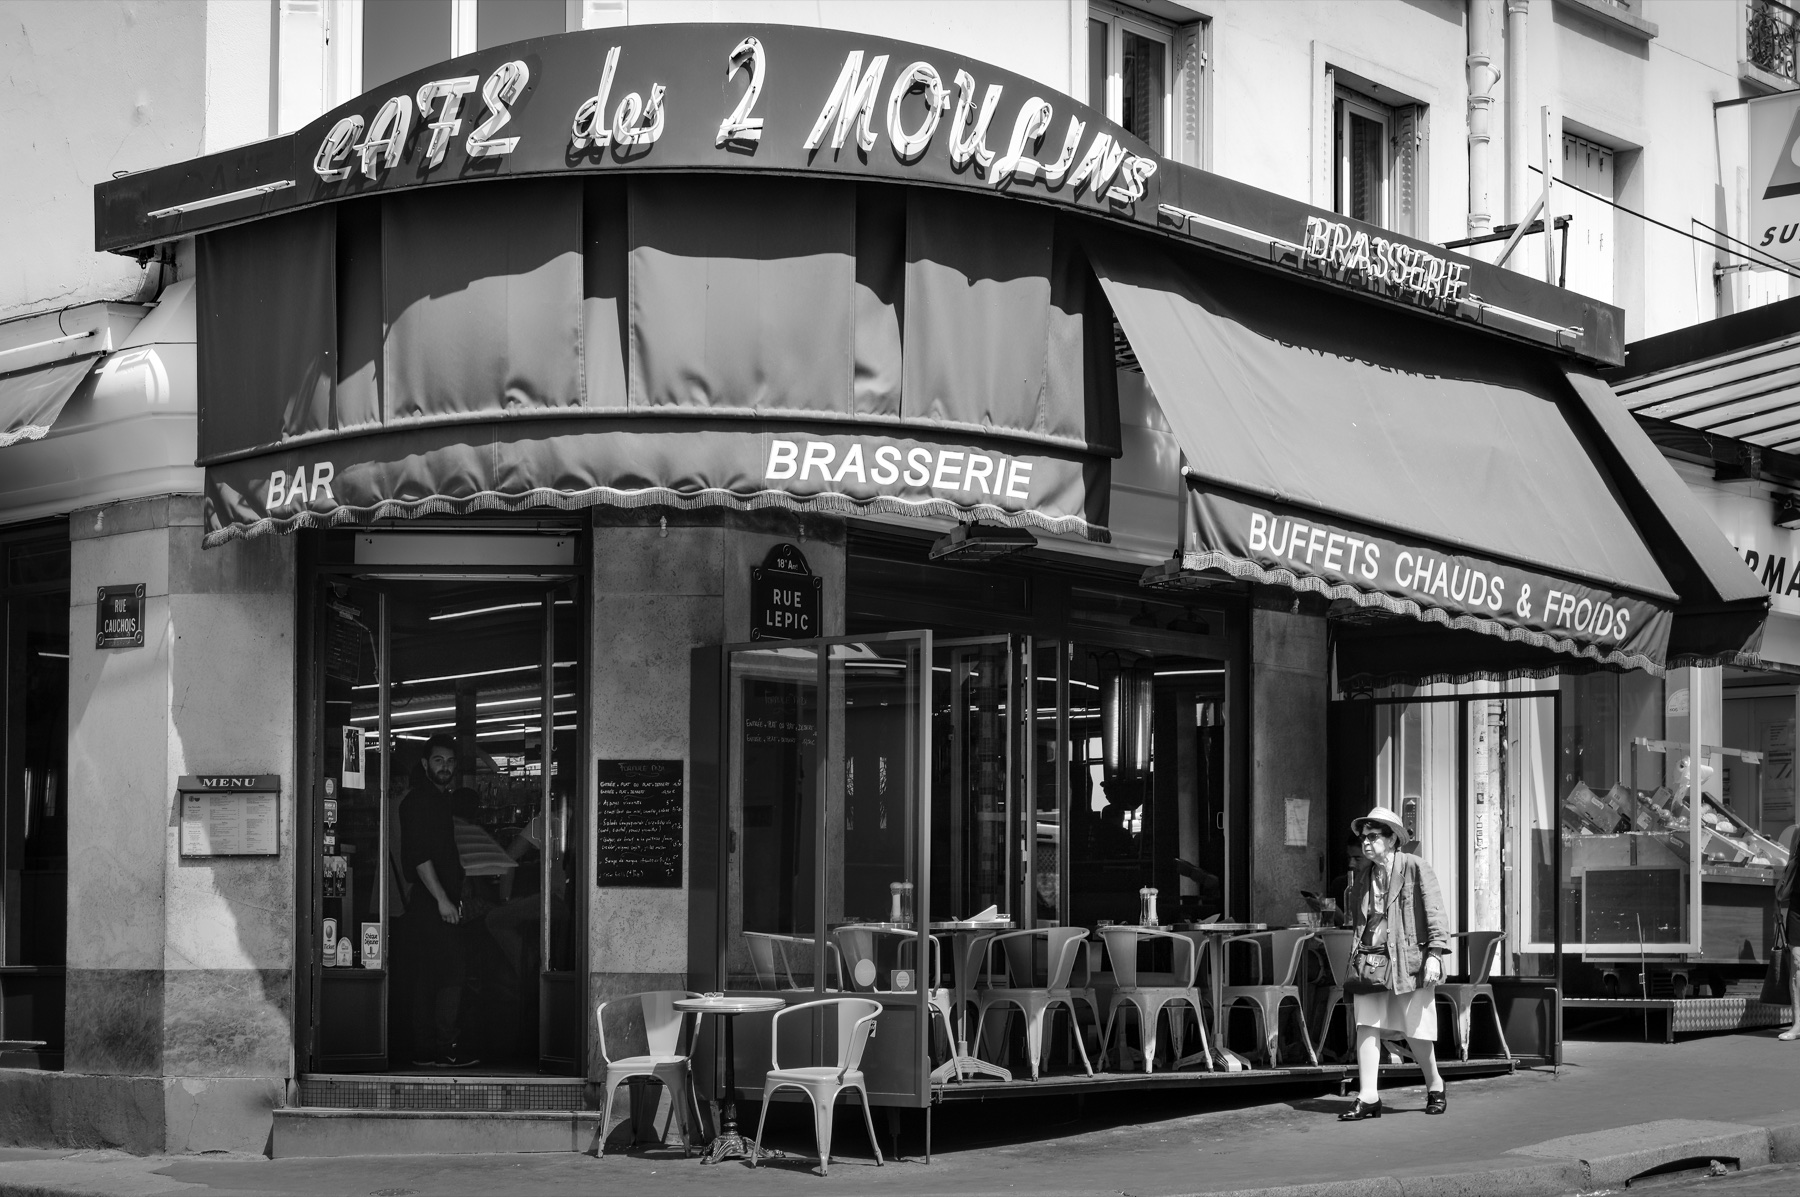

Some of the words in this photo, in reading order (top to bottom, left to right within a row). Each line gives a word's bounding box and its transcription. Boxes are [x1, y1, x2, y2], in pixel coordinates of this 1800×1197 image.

[572, 45, 666, 148] des
[714, 35, 766, 147] 2
[802, 49, 1158, 206] MOULINS
[1760, 222, 1800, 247] SU
[1303, 215, 1471, 302] BRASSERIE
[265, 461, 335, 510] BAR
[765, 440, 1033, 500] BRASSERIE
[1249, 512, 1381, 580] BUFFETS
[1394, 551, 1505, 612] CHAUDS
[1516, 583, 1532, 618] &
[1543, 589, 1631, 641] FROIDS
[1734, 547, 1800, 598] RMA
[114, 599, 127, 613] RUE
[773, 588, 802, 608] RUE
[104, 618, 136, 633] CAUCHOIS
[766, 609, 809, 631] LEPIC
[202, 778, 255, 787] MENU
